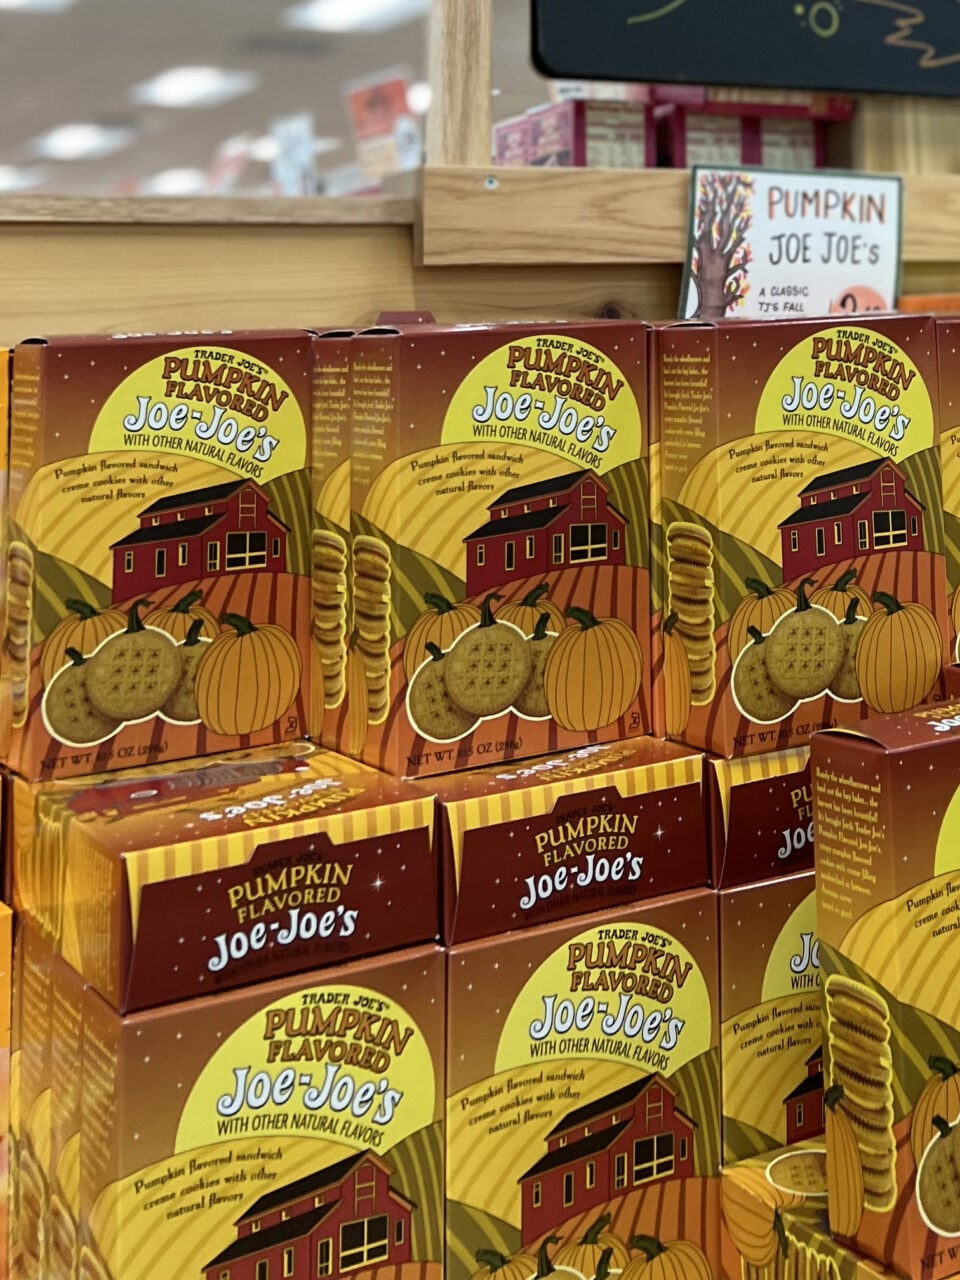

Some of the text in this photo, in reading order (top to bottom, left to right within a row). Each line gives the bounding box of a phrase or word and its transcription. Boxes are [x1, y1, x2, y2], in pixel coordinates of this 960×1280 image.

[768, 186, 886, 223] PUMPKIN
[769, 233, 812, 265] JOE
[759, 287, 809, 297] A CLASSIC
[784, 303, 805, 312] FALL
[536, 338, 601, 363] TRADER JOE'S
[836, 329, 894, 355] TRADER JOE'S
[194, 349, 266, 375] TRADER JOE'S
[507, 345, 624, 401] PUMPKIN
[812, 336, 916, 391] PUMPKIN
[814, 360, 901, 402] FLAVORED
[162, 356, 289, 412] PUMPKIN
[165, 380, 270, 422] FLAVORED
[510, 370, 606, 412] FLAVORED
[472, 386, 617, 453] Joe-Joe's
[782, 375, 910, 441] Joe-Joe's
[123, 395, 279, 464] Joe-Joe's
[782, 413, 899, 456] WITH OTHER NATURAL FLAVORS
[729, 439, 829, 460] Pumpkin flavored sandwich
[407, 753, 431, 766] NET
[477, 742, 493, 754] OZ
[534, 813, 638, 853] PUMPKIN
[544, 835, 629, 867] FLAVORED
[226, 863, 354, 909] PUMPKIN
[519, 852, 643, 910] Joe-Joe's
[236, 886, 341, 924] FLAVORED
[906, 893, 944, 912] Pumpkin
[914, 910, 938, 929] creme
[207, 904, 359, 973] Joe-Joe's
[598, 929, 668, 948] TRADER JOE'S
[932, 922, 960, 939] natural
[567, 941, 693, 988] PUMPKIN
[302, 993, 384, 1012] TRADER JOE'S
[571, 971, 674, 1003] FLAVORED
[264, 1005, 414, 1056] PUMPKIN
[529, 992, 685, 1051] Joe-Joe's
[266, 1039, 391, 1073] FLAVORED
[529, 1038, 671, 1070] WITH OTHER NATURAL FLAVORS
[216, 1063, 403, 1126] Joe-Joe's
